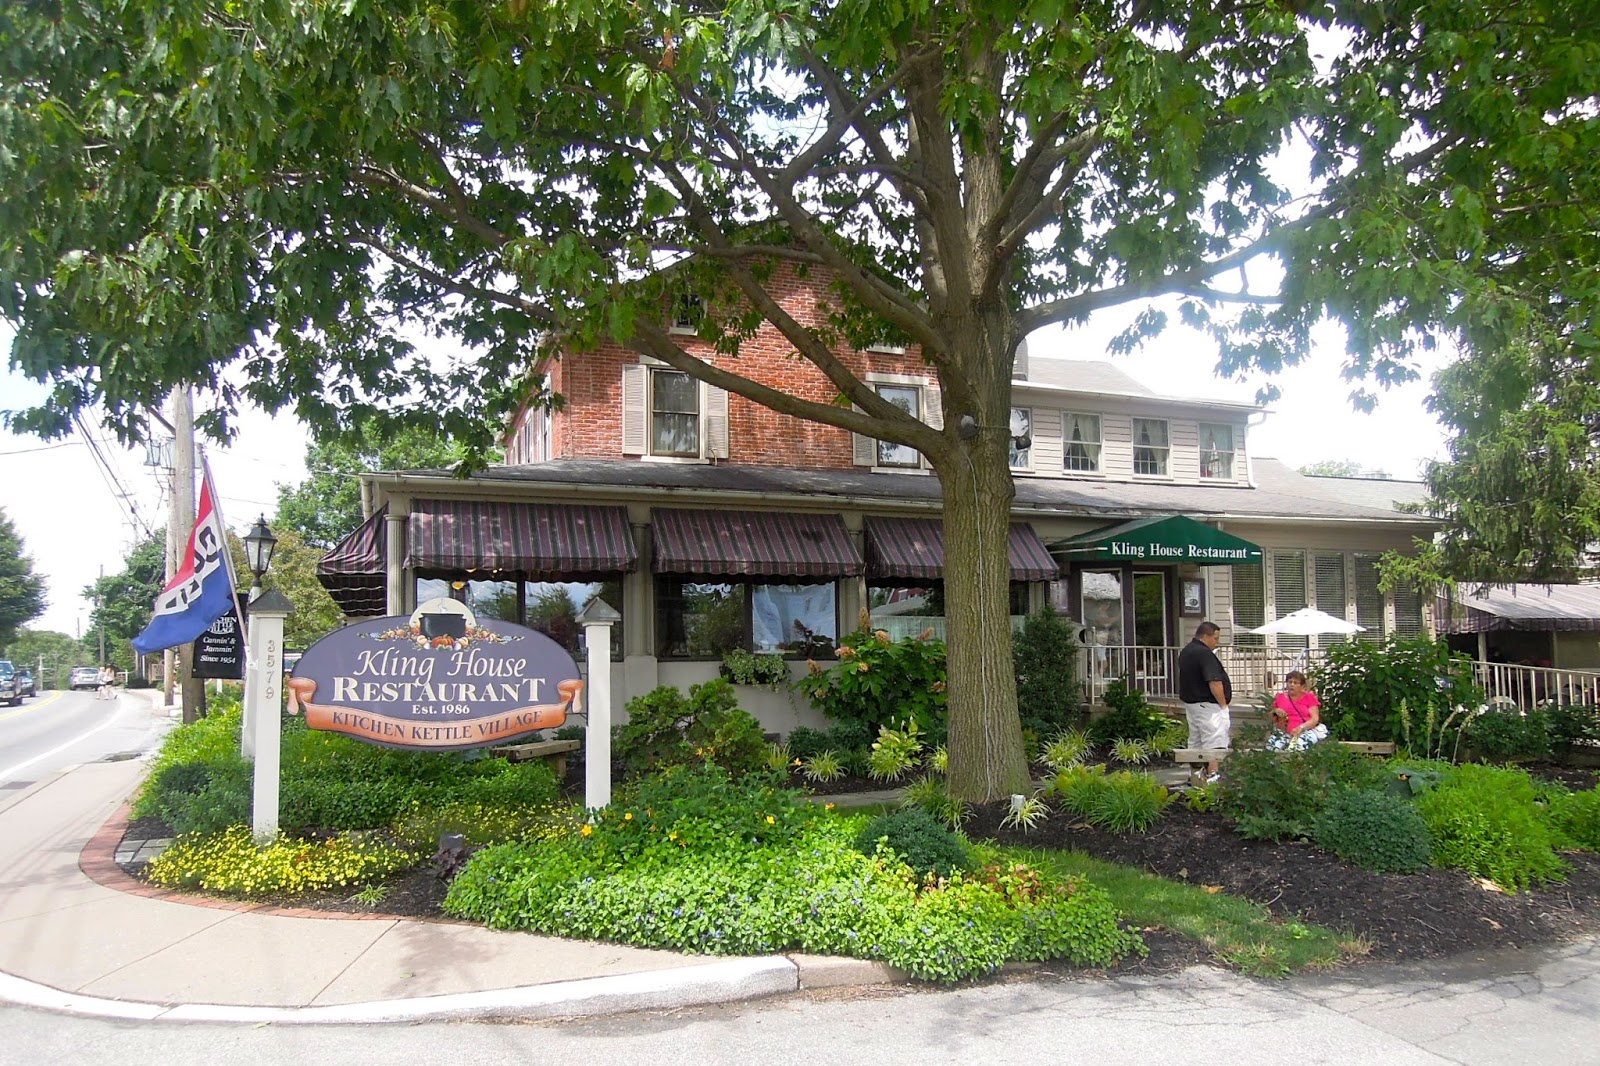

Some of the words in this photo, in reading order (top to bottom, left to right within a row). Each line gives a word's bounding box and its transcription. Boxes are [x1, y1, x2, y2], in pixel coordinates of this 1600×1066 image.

[1111, 541, 1145, 558] Kling
[1149, 543, 1184, 557] House
[1188, 544, 1247, 559] Restaurant
[203, 636, 230, 644] Cannin'
[229, 637, 236, 645] &
[203, 645, 235, 653] Jammin'
[200, 654, 219, 663] Since
[220, 656, 236, 664] 1954
[353, 646, 435, 687] Kling
[446, 646, 527, 678] House
[332, 676, 546, 703] RESTAURANT
[412, 704, 437, 715] Est.
[441, 704, 471, 715] 1986
[332, 711, 405, 738] KITCHEN
[411, 725, 472, 740] KETTLE
[478, 710, 544, 736] VILLAGE
